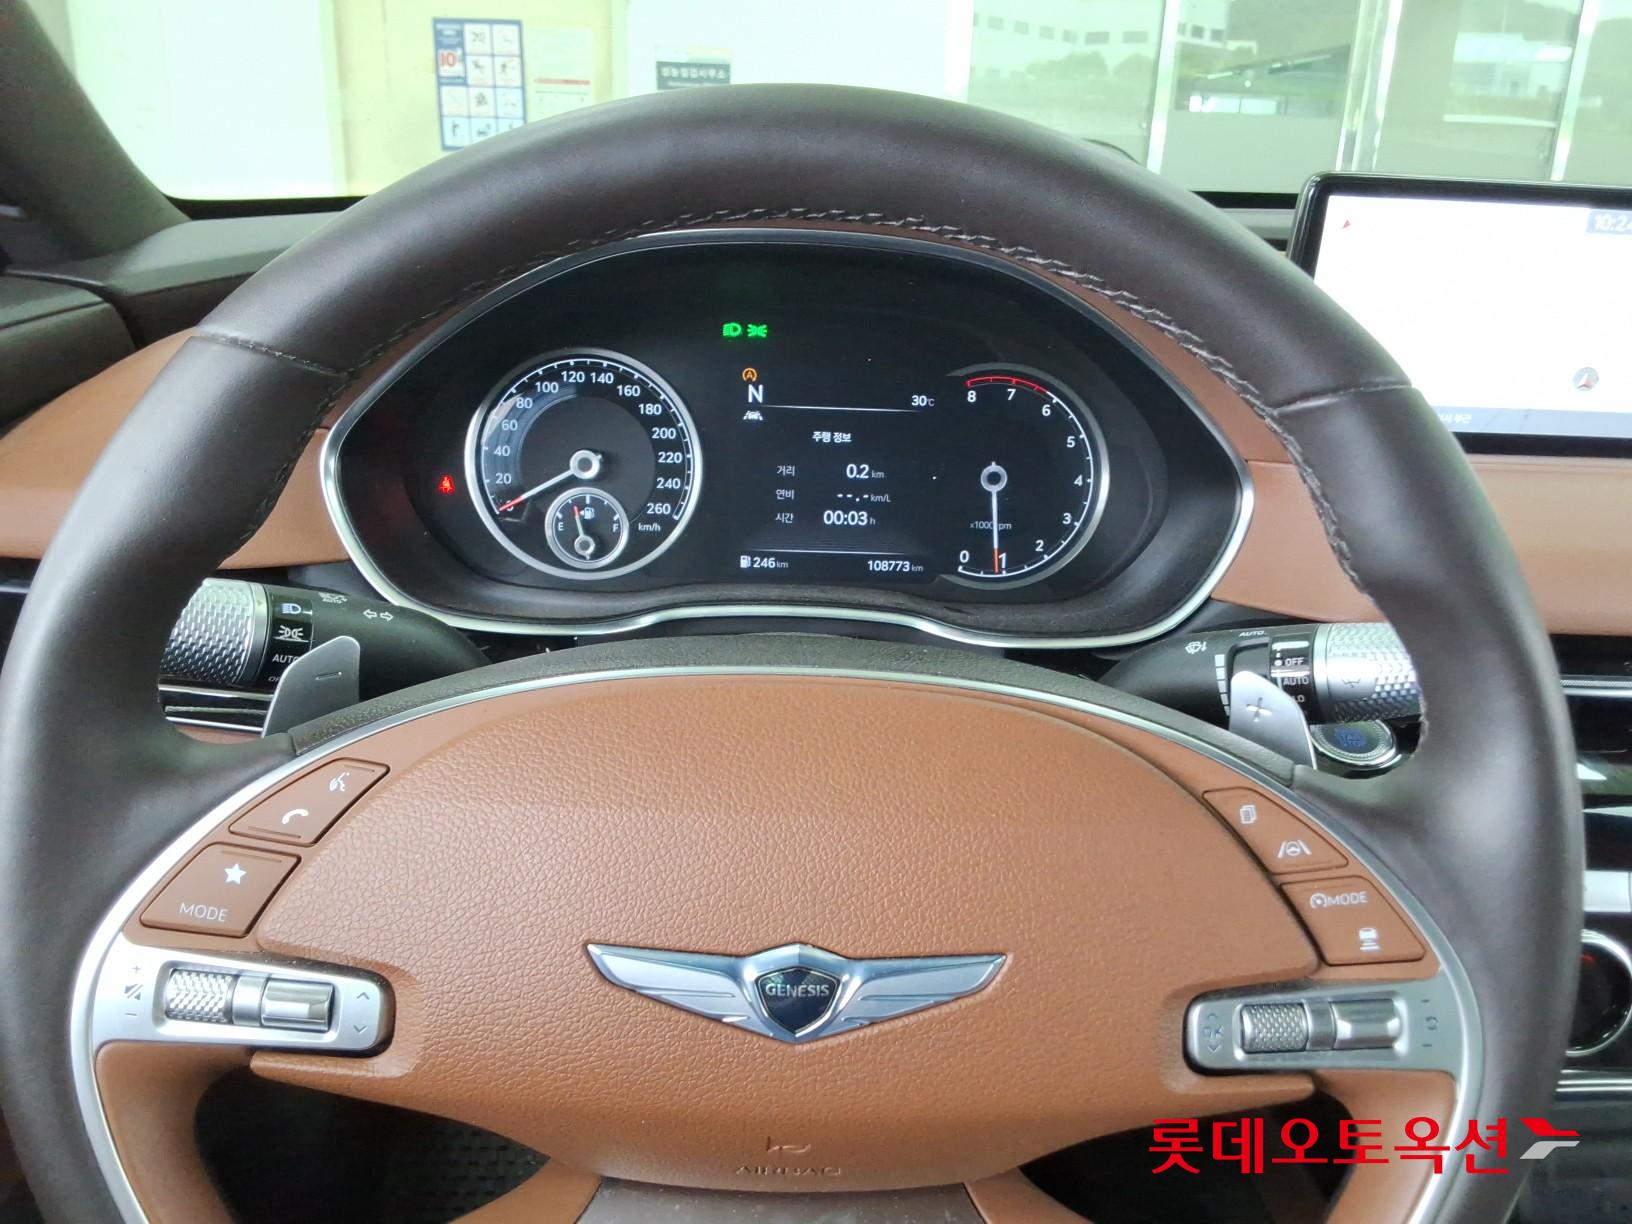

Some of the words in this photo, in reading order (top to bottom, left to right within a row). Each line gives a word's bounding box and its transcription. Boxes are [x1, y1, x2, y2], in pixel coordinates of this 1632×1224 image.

[1595, 214, 1632, 231] 10:2
[561, 371, 585, 383] 120
[590, 372, 614, 384] 140
[535, 382, 559, 393] 100
[617, 385, 641, 398] 160
[748, 384, 763, 403] N
[967, 391, 976, 403] 8
[1007, 388, 1016, 401] 7
[516, 397, 533, 409] 80
[638, 404, 662, 416] 180
[1042, 404, 1051, 416] 6
[502, 420, 518, 431] 60
[652, 427, 676, 439] 200
[812, 431, 831, 443] 주행
[833, 431, 852, 443] 정보
[1066, 436, 1075, 448] 5
[493, 445, 511, 457] 40
[658, 452, 682, 464] 220
[776, 465, 795, 476] 거리
[846, 464, 869, 479] 0.2
[495, 473, 512, 484] 20
[656, 478, 681, 489] 240
[1074, 474, 1083, 486] 4
[775, 489, 794, 500] 연비
[646, 503, 671, 515] 260
[775, 512, 794, 524] 시간
[823, 510, 868, 525] 00:03
[1062, 513, 1072, 525] 3
[558, 522, 564, 531] E
[613, 523, 619, 532] F
[638, 523, 661, 532] km/h
[1035, 540, 1044, 551] 2
[959, 550, 970, 563] 0
[998, 552, 1007, 569] 1
[753, 557, 775, 569] 246
[867, 560, 910, 572] 108773
[1285, 657, 1304, 667] OFF
[1283, 676, 1309, 686] AUTO
[1328, 891, 1368, 905] MODE
[180, 902, 228, 922] MODE
[765, 983, 830, 998] GENESIS
